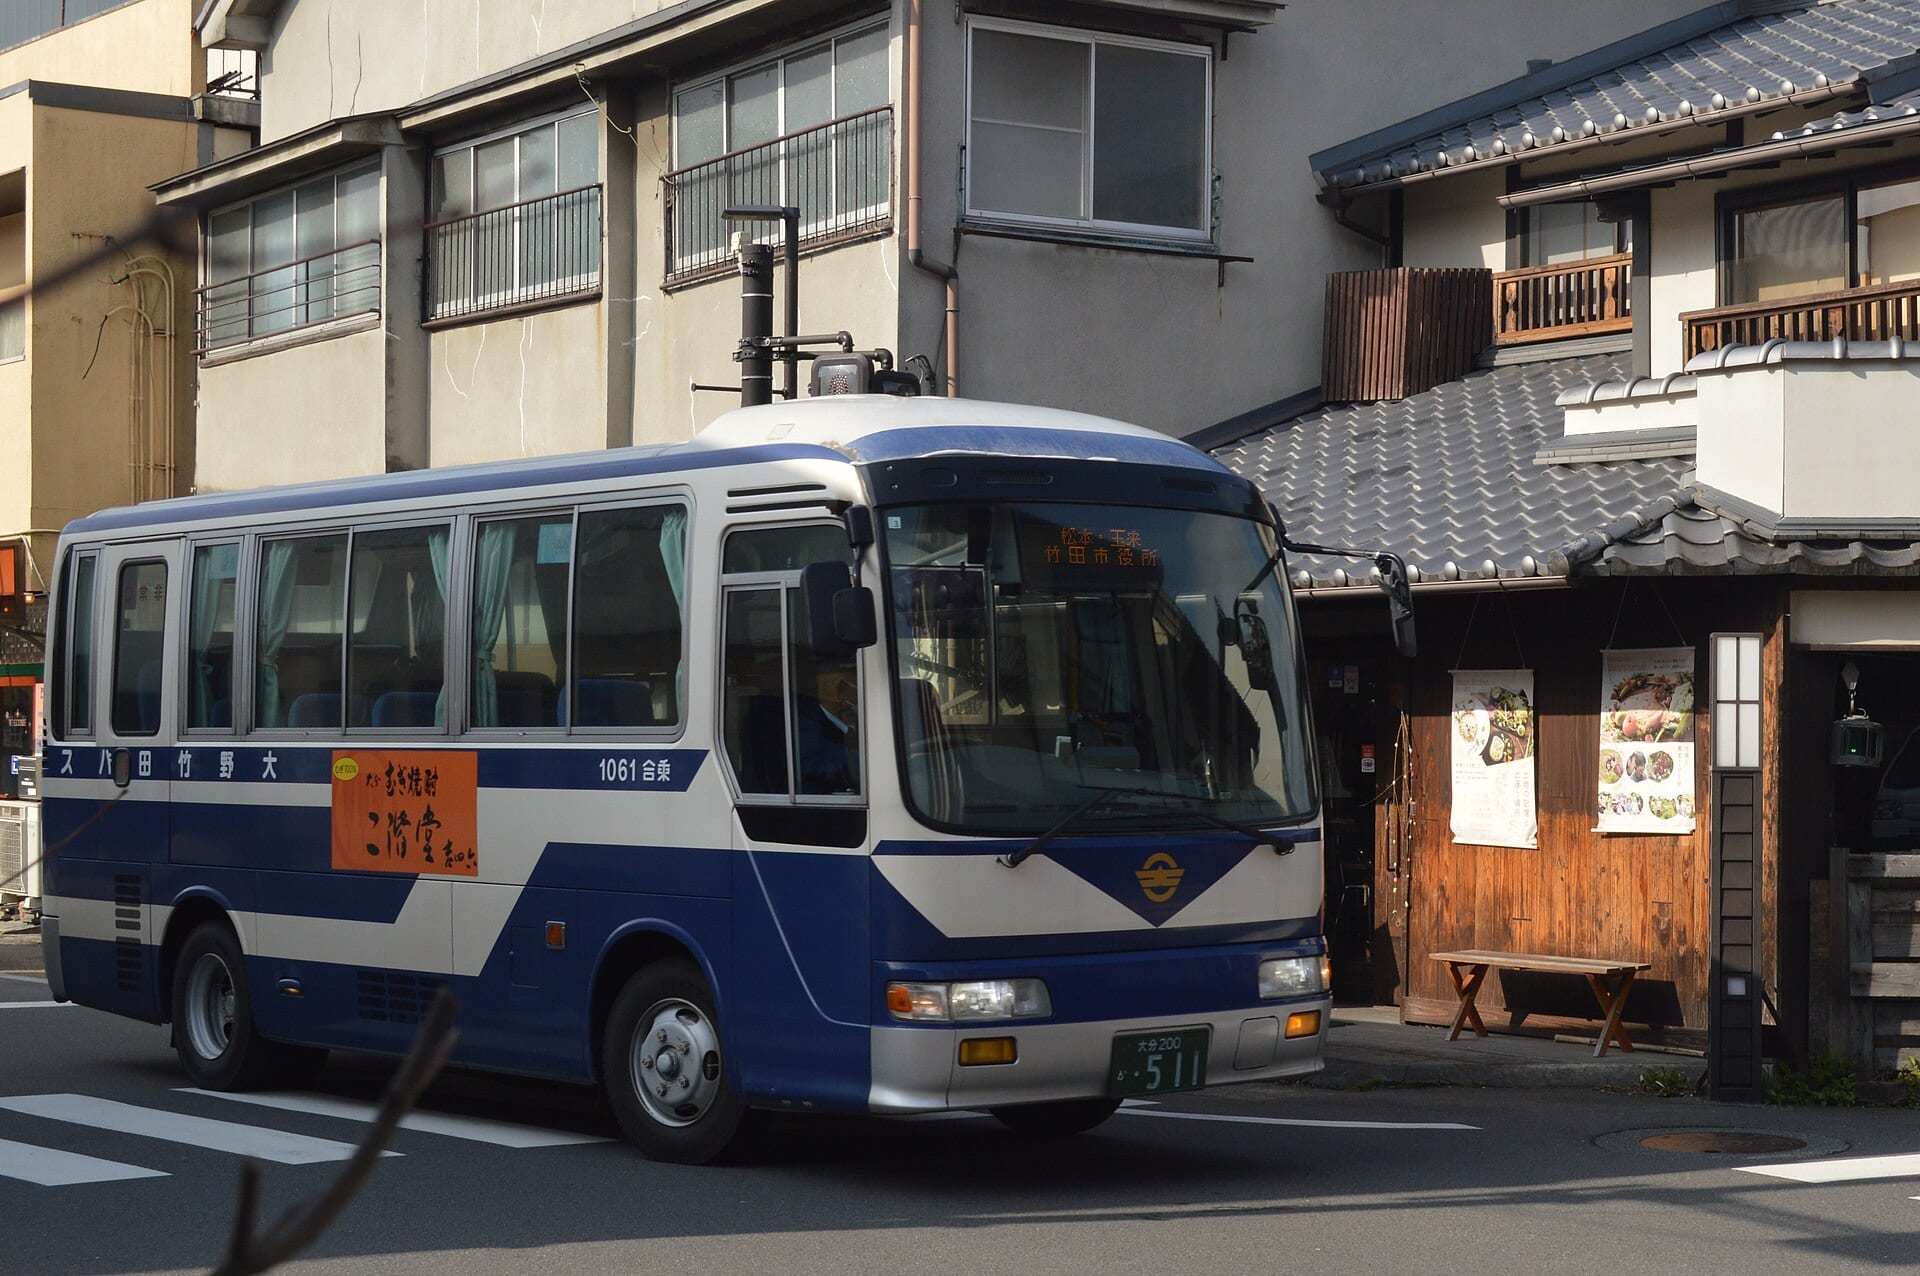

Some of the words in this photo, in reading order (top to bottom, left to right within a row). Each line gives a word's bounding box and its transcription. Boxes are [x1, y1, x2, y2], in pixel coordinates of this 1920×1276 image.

[1045, 545, 1160, 567] 竹田市役所
[599, 758, 636, 782] 1061
[366, 803, 442, 863] 二階堂
